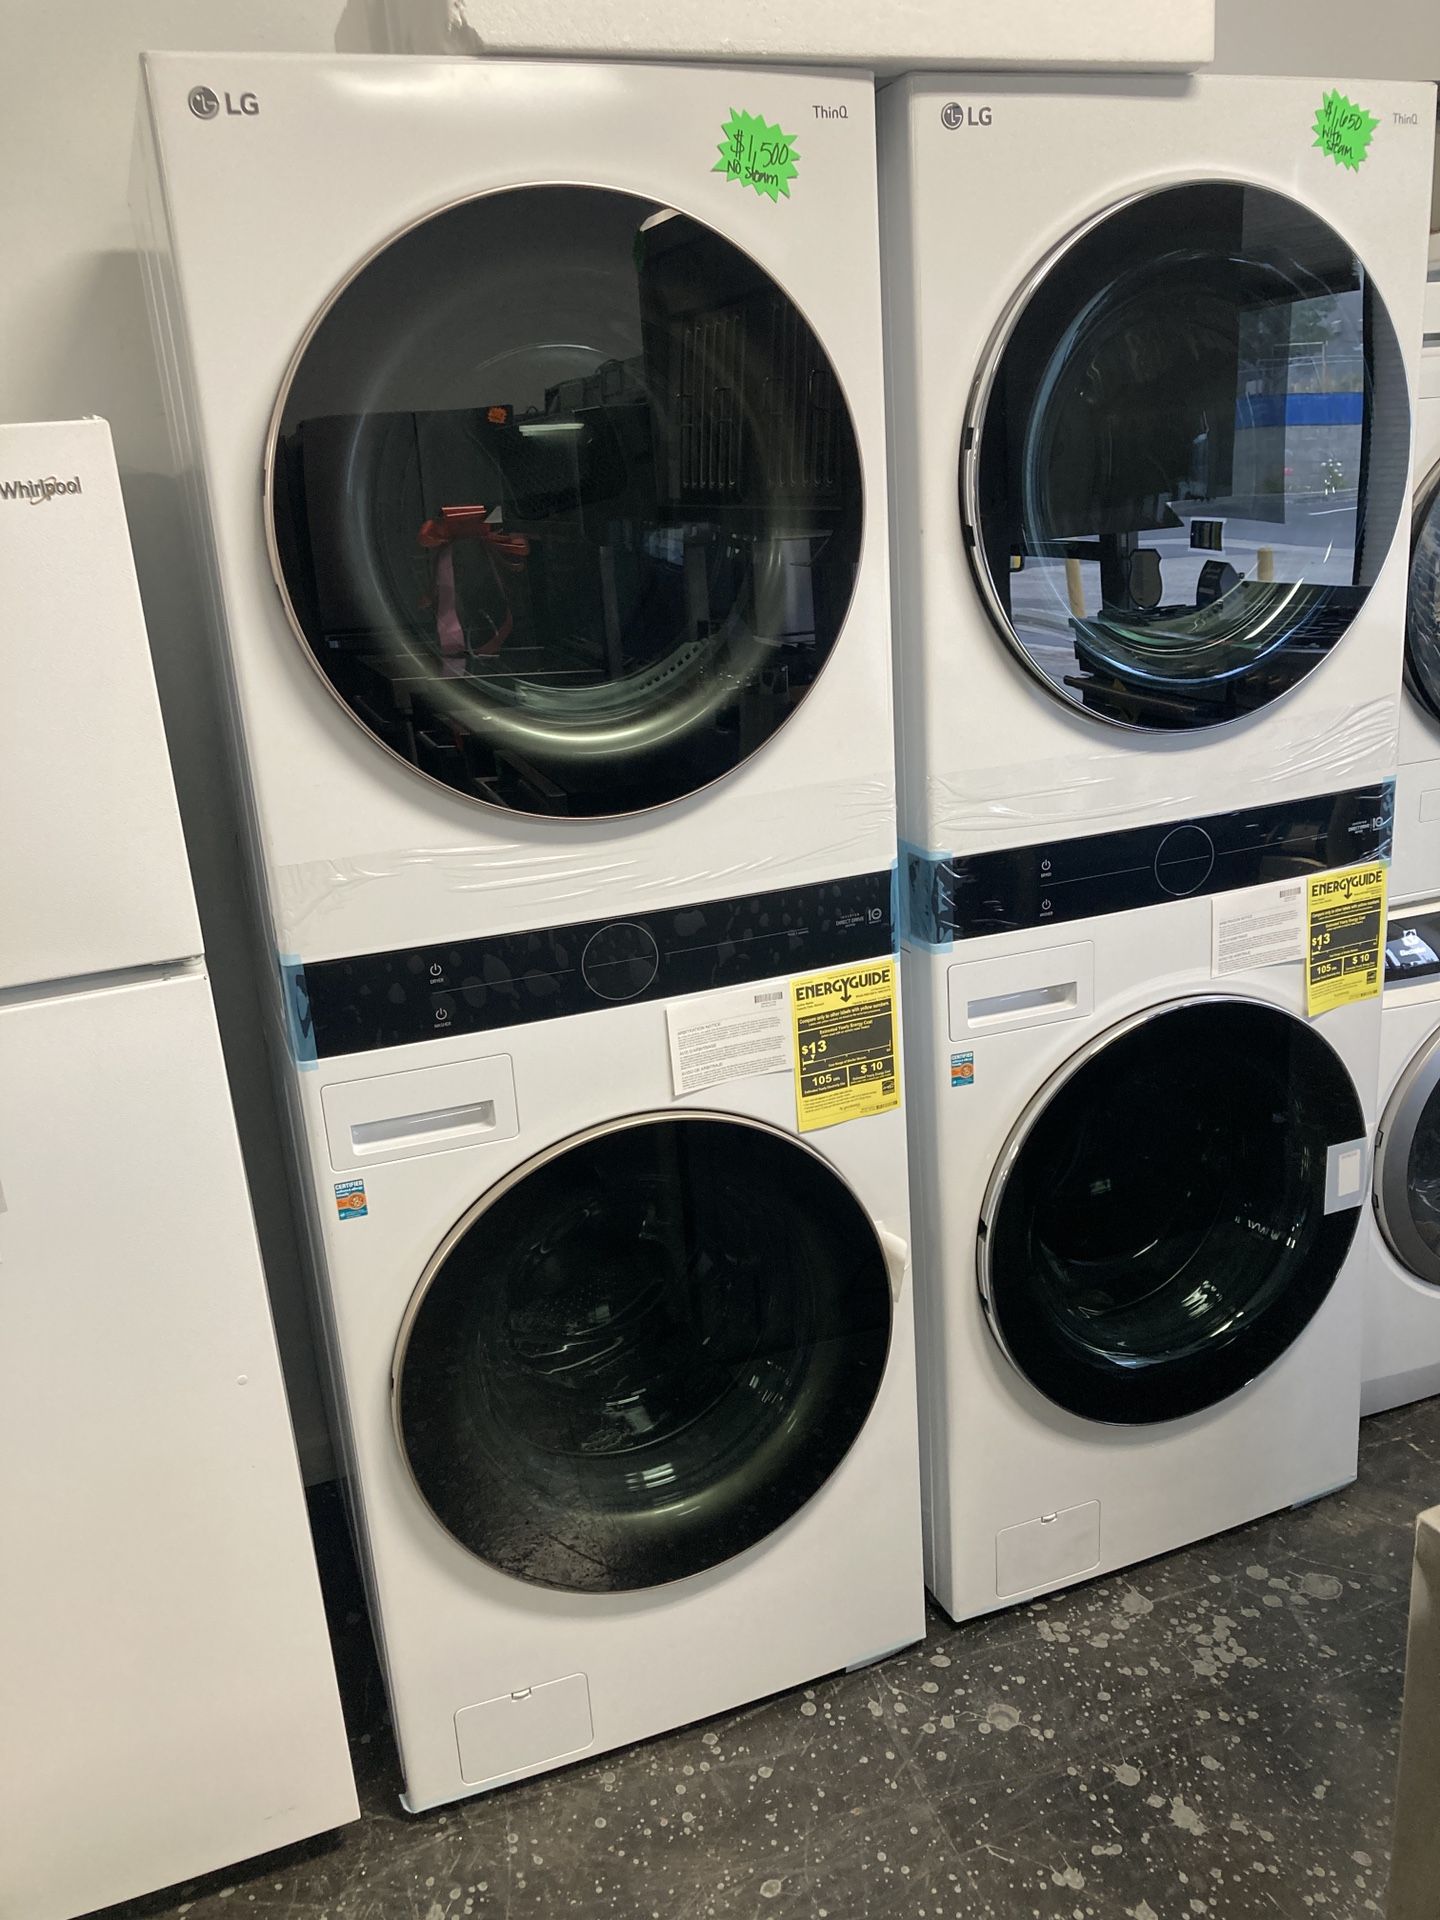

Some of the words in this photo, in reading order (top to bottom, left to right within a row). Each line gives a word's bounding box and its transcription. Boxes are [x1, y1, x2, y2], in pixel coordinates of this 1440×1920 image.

[224, 92, 260, 116] LG
[812, 105, 849, 119] ThinQ
[967, 106, 992, 126] LG
[1324, 100, 1363, 131] $1,650
[1393, 112, 1418, 125] ThinQ
[730, 129, 789, 168] $1,500
[0, 475, 82, 502] Whirlpool
[1311, 870, 1383, 899] ENERGYGUIDE
[1311, 932, 1331, 946] $13
[1360, 953, 1370, 963] 10
[1316, 963, 1332, 975] 105
[795, 968, 891, 1002] ENERGYGUIDE
[801, 1039, 828, 1055] $13
[870, 1061, 883, 1072] 10
[811, 1073, 833, 1087] 105
